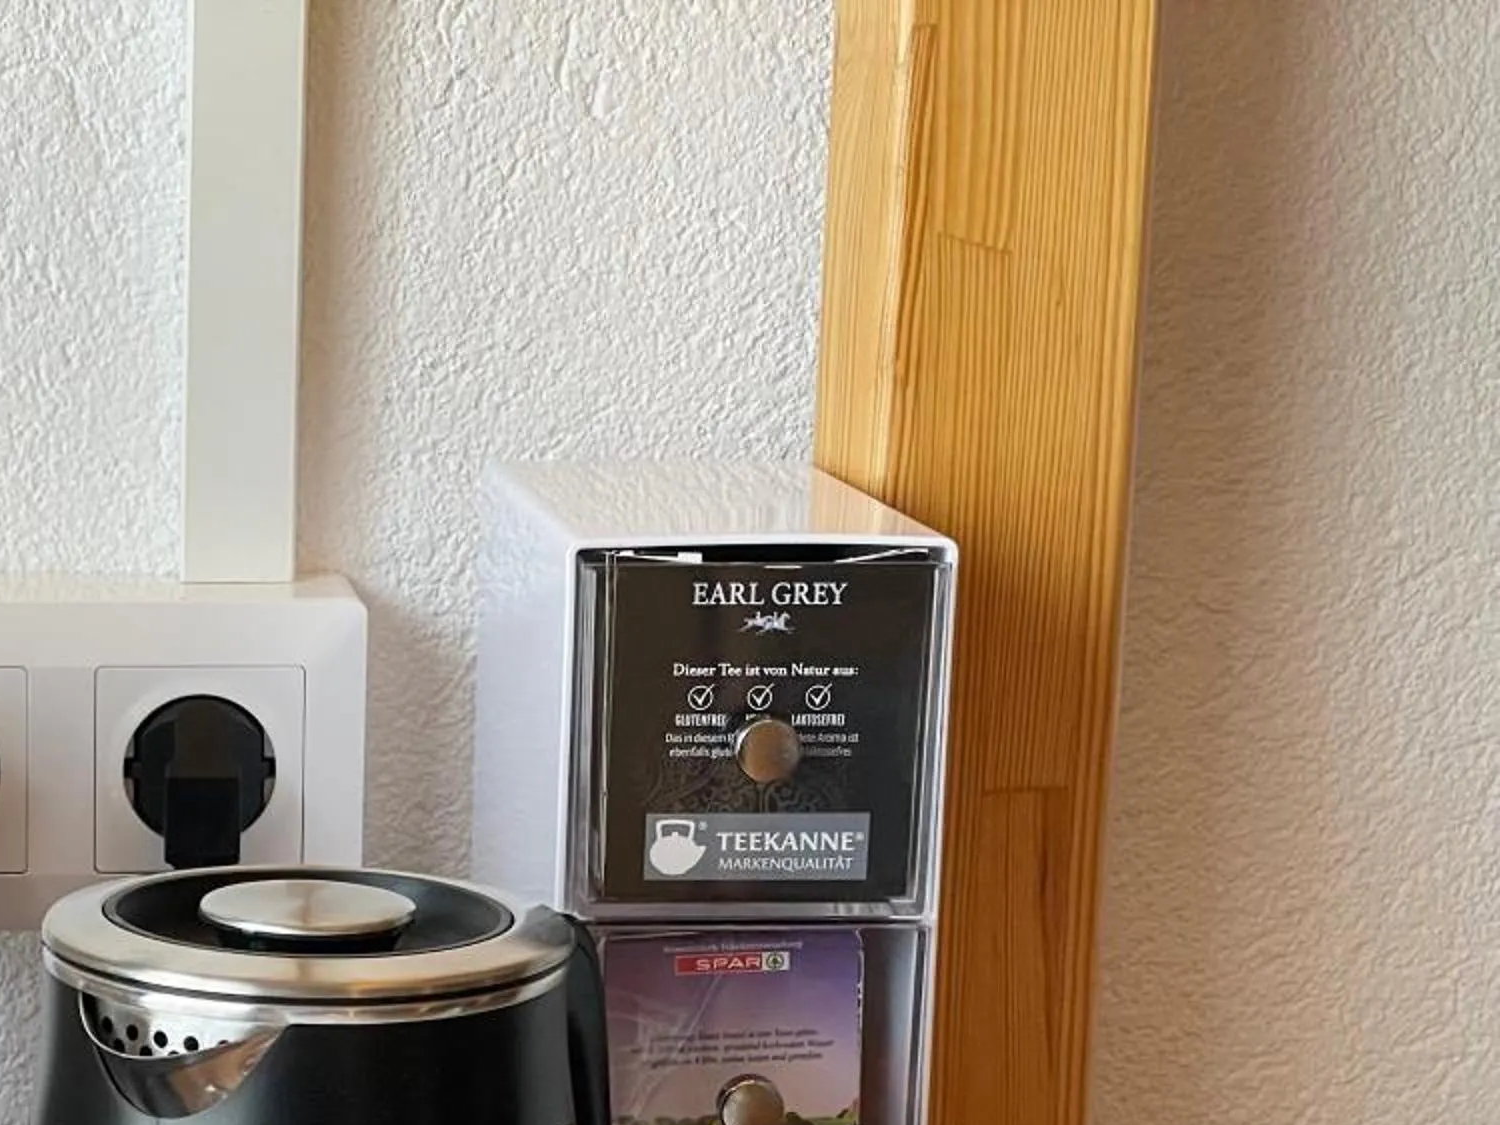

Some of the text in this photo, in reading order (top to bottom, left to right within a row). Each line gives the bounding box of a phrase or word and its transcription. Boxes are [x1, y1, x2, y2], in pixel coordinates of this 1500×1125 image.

[691, 581, 849, 605] EARL GREY
[673, 663, 716, 677] Dieser
[718, 663, 742, 677] Tee
[745, 664, 760, 676] ist
[763, 666, 788, 676] von
[791, 663, 829, 676] Natur
[695, 957, 762, 971] SPAR
